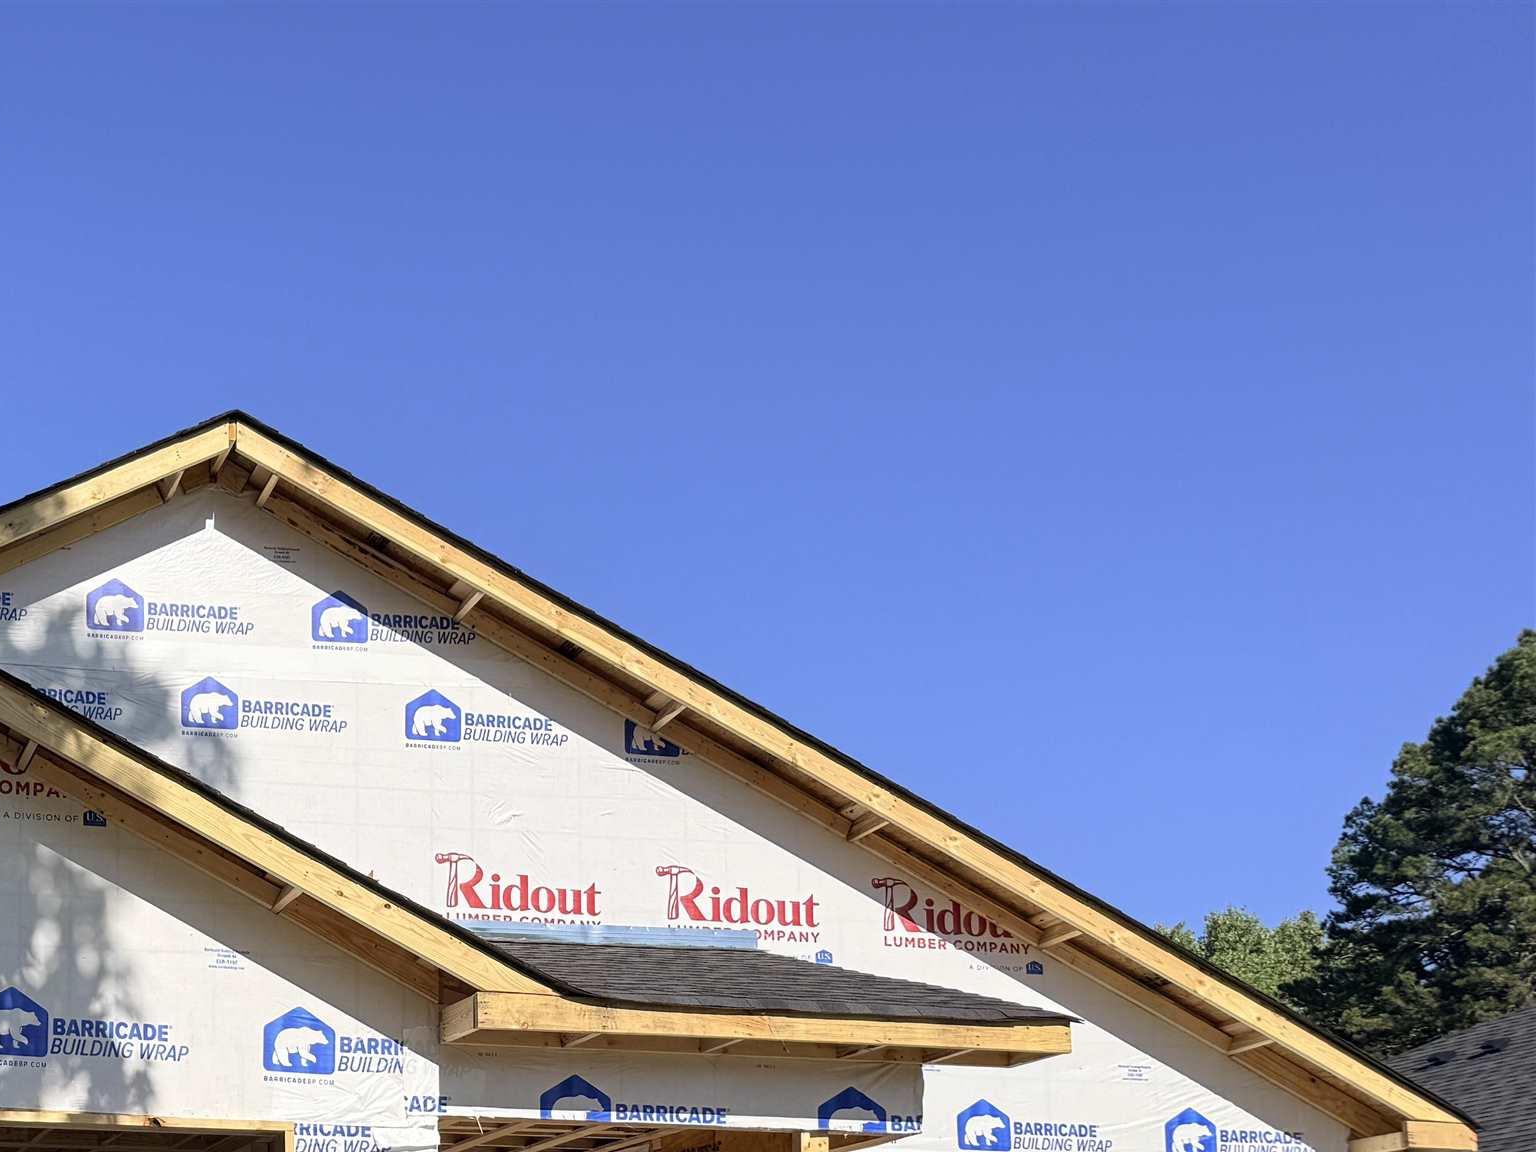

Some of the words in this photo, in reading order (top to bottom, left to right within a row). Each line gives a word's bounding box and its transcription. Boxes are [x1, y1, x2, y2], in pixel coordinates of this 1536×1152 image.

[148, 603, 237, 620] BARRICADE
[146, 618, 210, 634] BUILDING
[215, 622, 254, 636] WRAP
[372, 614, 460, 630] BARRICADE
[370, 629, 432, 644] BUILDING
[438, 631, 476, 646] WRAP
[82, 706, 122, 721] WRAP
[242, 700, 332, 718] BARRICADE
[240, 715, 304, 731] BUILDING
[308, 720, 348, 734] WRAP
[465, 713, 553, 732] BARRICADE
[464, 728, 525, 745] BUILDING
[530, 732, 568, 747] WRAP
[14, 812, 61, 822] DIVISION
[435, 852, 602, 918] Ridout
[656, 865, 820, 929] Ridout
[754, 930, 820, 944] OMPANY
[884, 936, 947, 950] LUMBER
[954, 940, 1031, 954] COMPANY
[53, 1018, 169, 1042] BARRICADE
[50, 1038, 133, 1058] BUILDING
[140, 1042, 188, 1062] WRAP
[340, 1037, 404, 1056] BARRI
[338, 1056, 404, 1074] BUILDIN
[616, 1104, 726, 1124] BARRICADE
[1014, 1122, 1097, 1138] BARRICADE
[1014, 1136, 1072, 1152] BUILDING
[1076, 1140, 1113, 1152] WRAP
